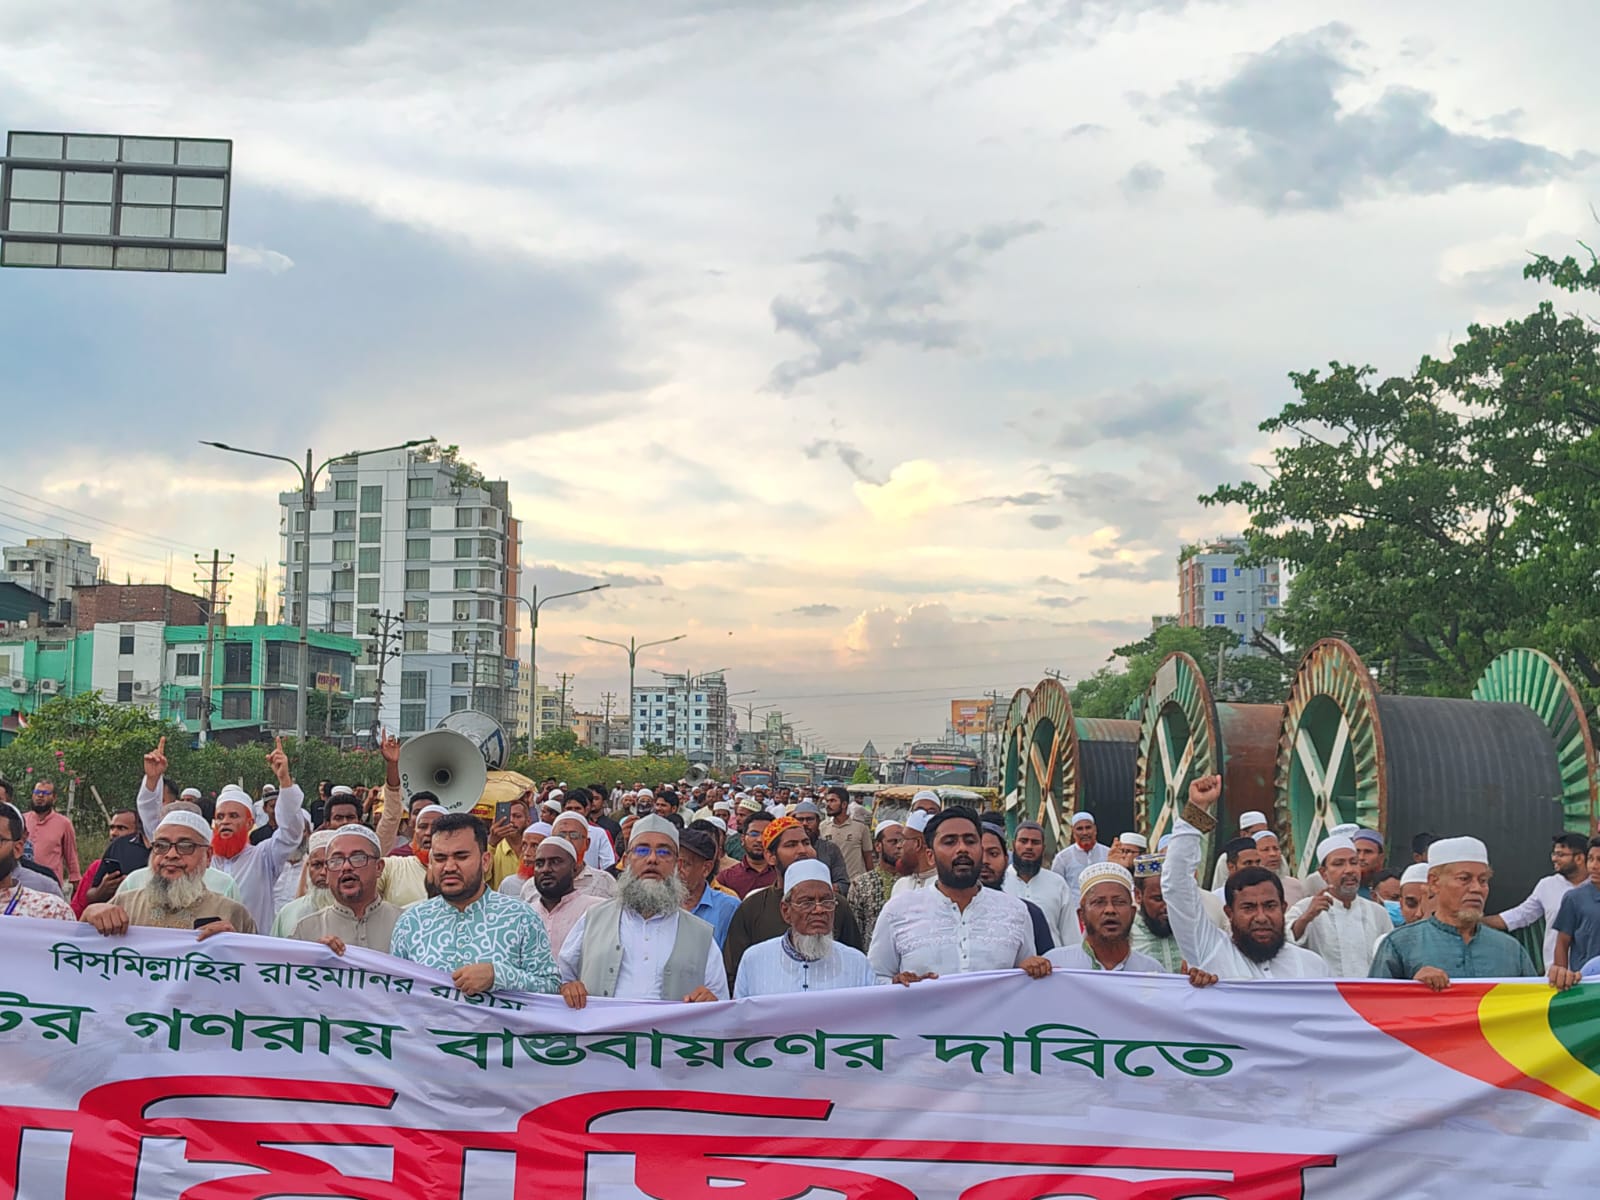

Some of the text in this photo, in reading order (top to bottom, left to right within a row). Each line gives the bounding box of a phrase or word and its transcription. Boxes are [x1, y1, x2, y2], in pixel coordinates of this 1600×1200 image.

[125, 1008, 409, 1060] গণরায়
[427, 1027, 900, 1071] বাস্তবায়ণের
[917, 1023, 1249, 1079] দাবিতে
